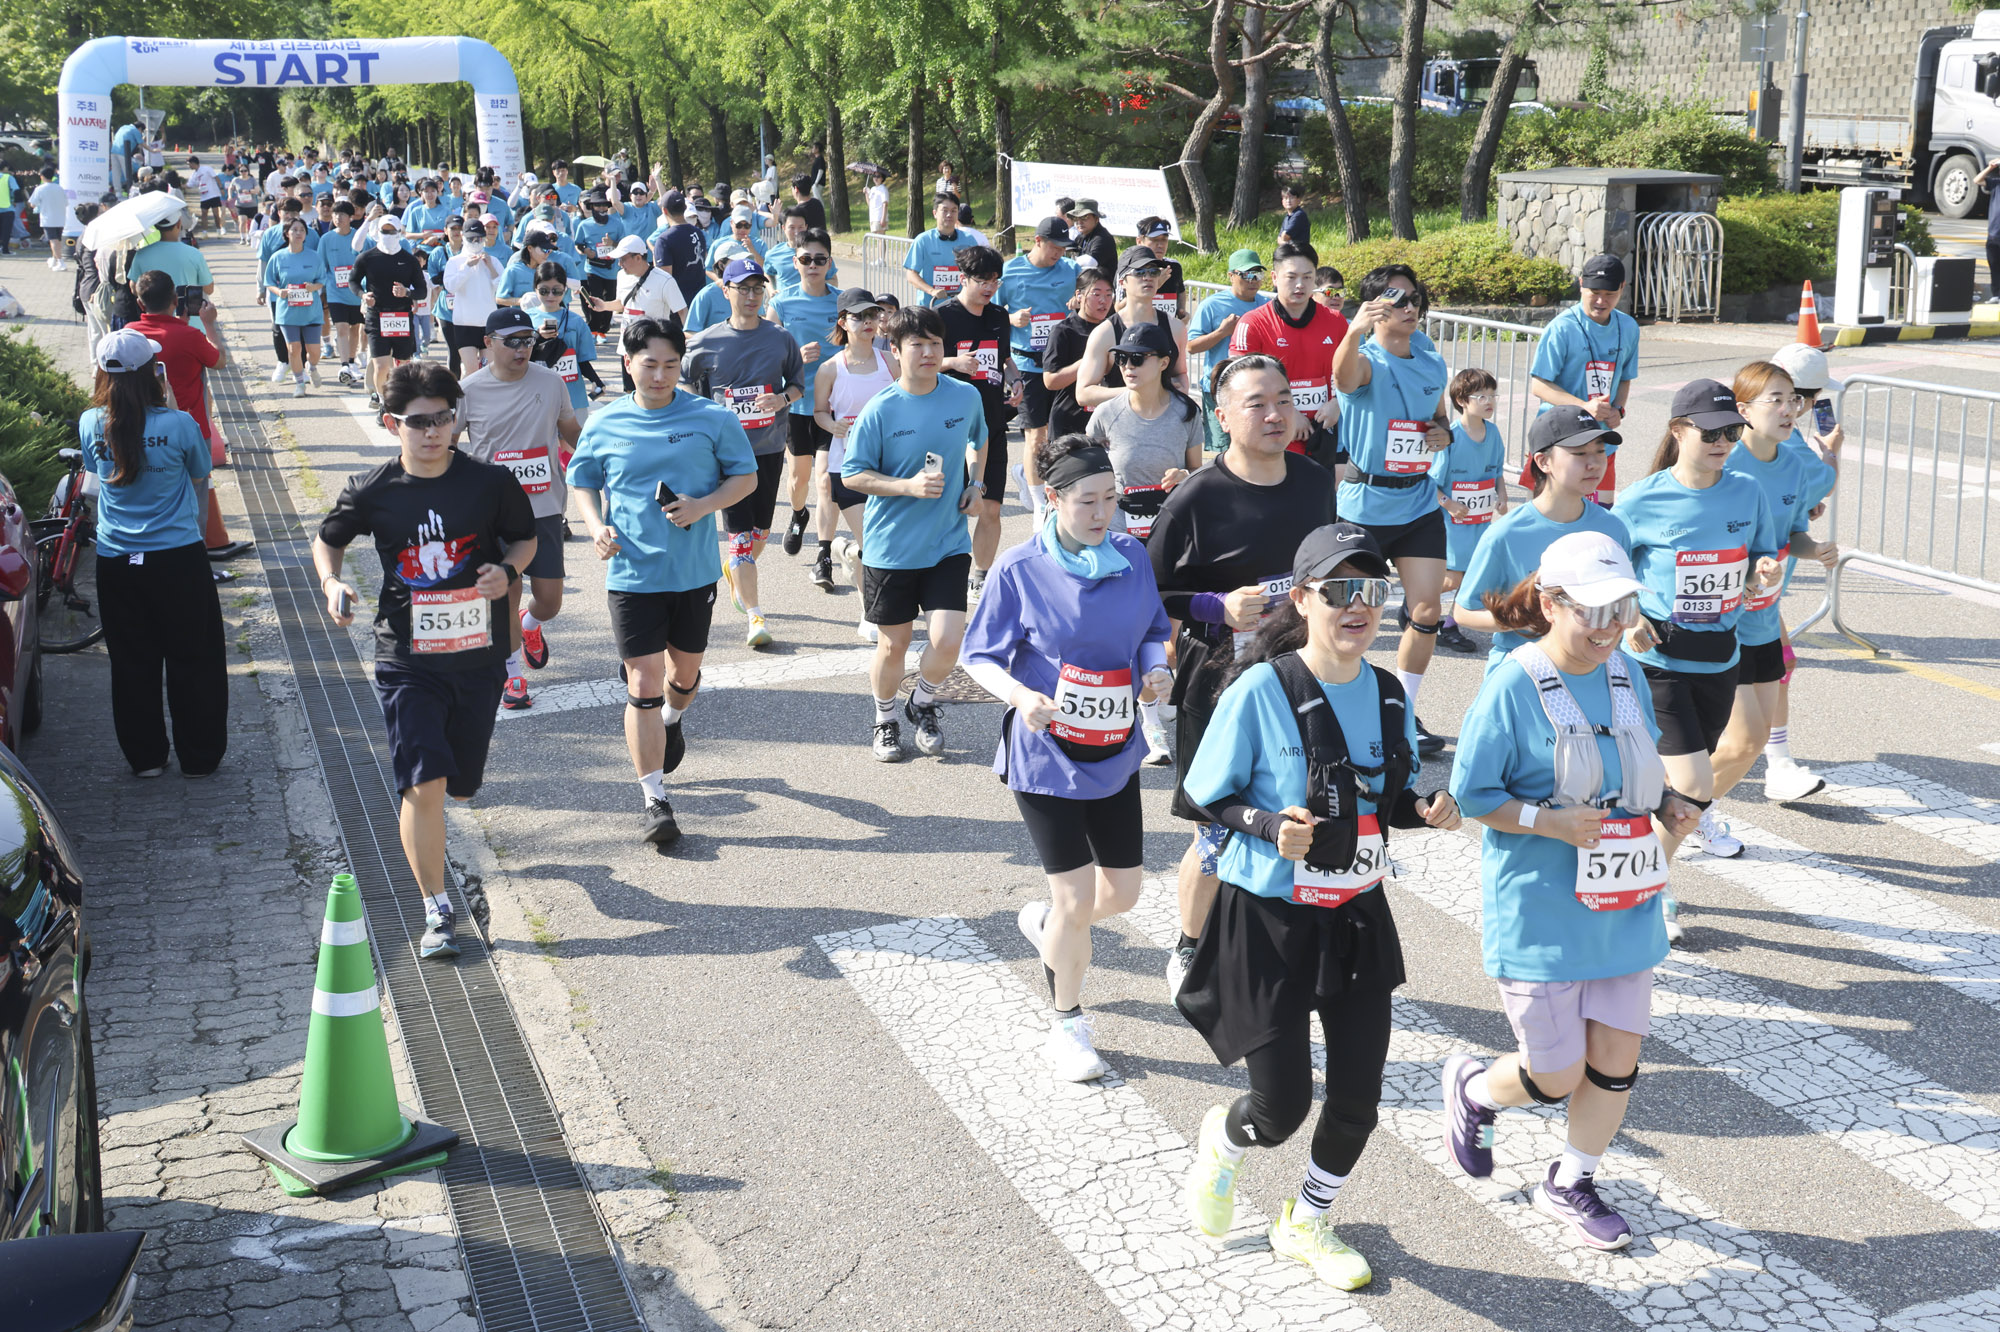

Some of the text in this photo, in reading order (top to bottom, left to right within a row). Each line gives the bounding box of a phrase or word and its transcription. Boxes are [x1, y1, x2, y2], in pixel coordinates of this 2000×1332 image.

[213, 52, 380, 86] START
[77, 101, 97, 111] 주최
[490, 99, 509, 108] 협찬
[67, 117, 107, 129] 시사저널
[79, 140, 99, 151] 주관
[935, 274, 960, 283] 5544
[289, 290, 310, 299] 5637
[383, 320, 407, 329] 5687
[739, 387, 759, 396] 0134
[731, 402, 761, 416] 562
[508, 464, 547, 480] 668
[1457, 494, 1491, 510] 5671
[1269, 580, 1292, 593] 013
[1683, 569, 1743, 595] 5641
[1682, 601, 1713, 611] 0133
[1724, 603, 1729, 611] 5
[420, 607, 481, 631] 5543
[461, 637, 481, 648] 5 km
[1060, 692, 1129, 720] 5594
[1103, 733, 1124, 744] 5 km
[1280, 746, 1303, 757] AIRi
[1600, 823, 1631, 837] 사저널
[1587, 845, 1661, 880] 5704
[1636, 893, 1643, 902] 5
